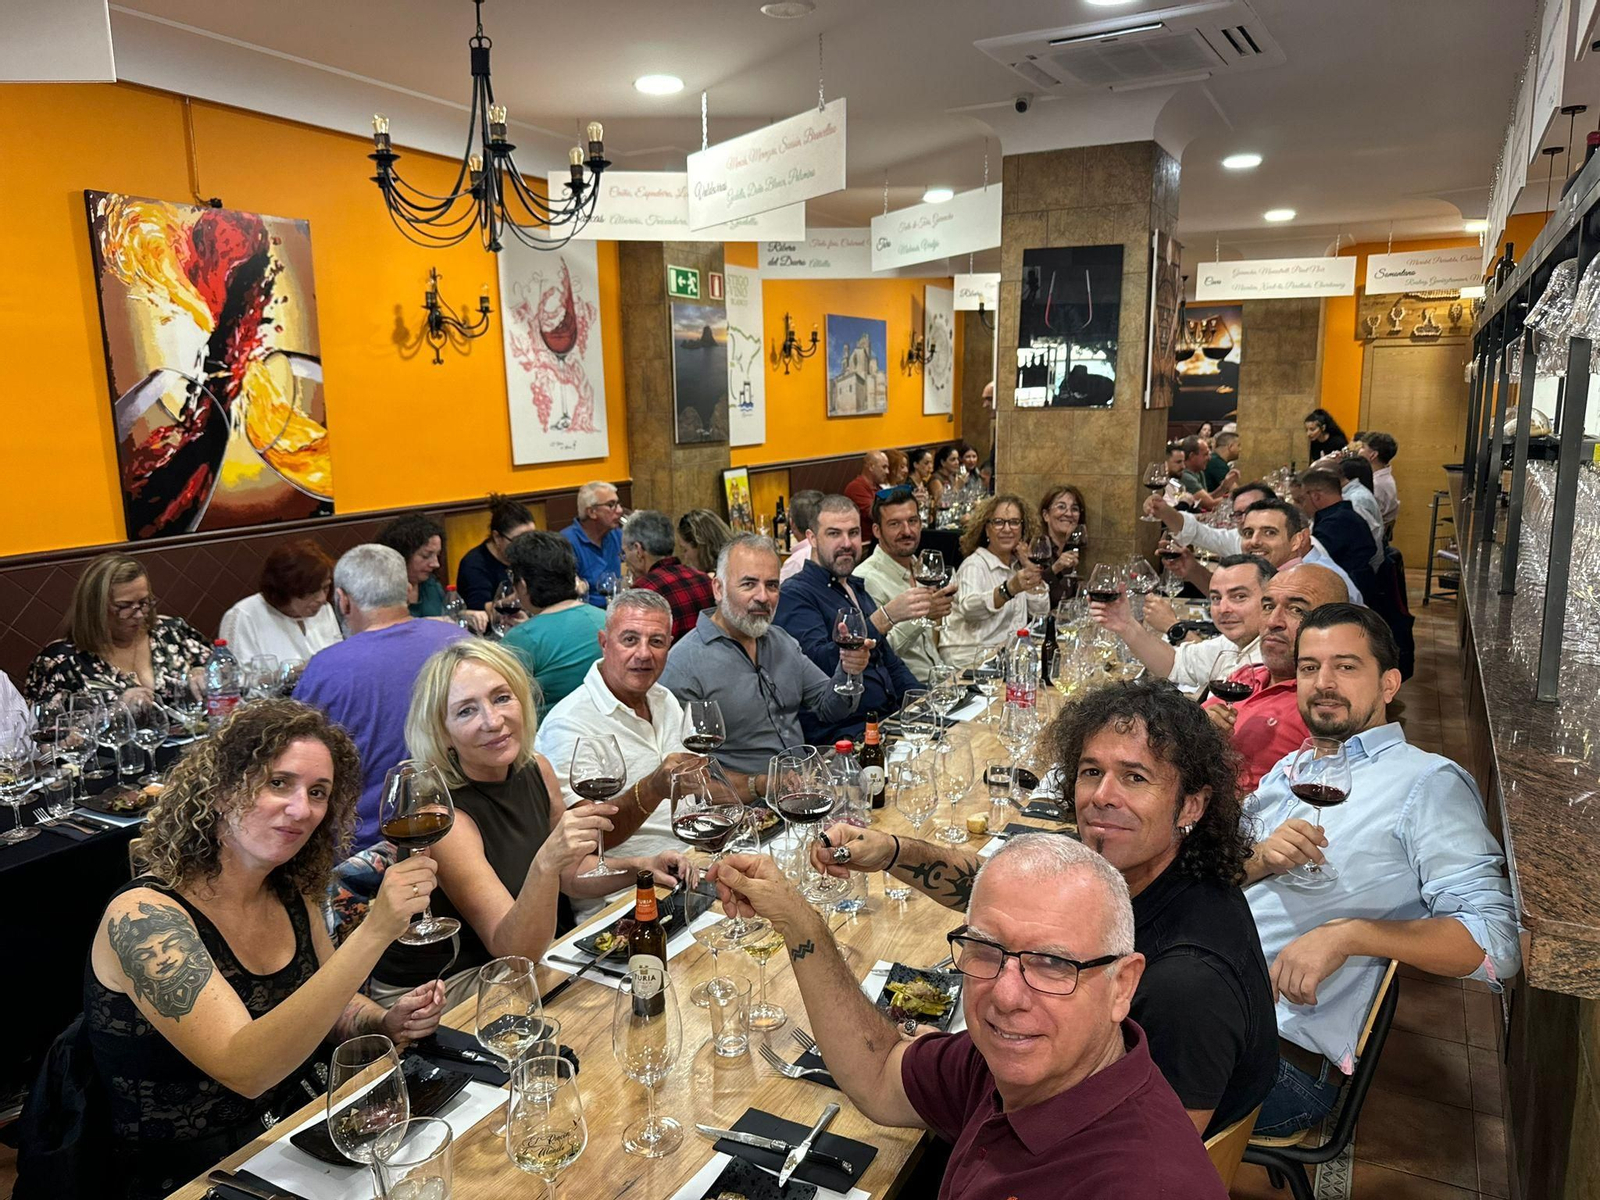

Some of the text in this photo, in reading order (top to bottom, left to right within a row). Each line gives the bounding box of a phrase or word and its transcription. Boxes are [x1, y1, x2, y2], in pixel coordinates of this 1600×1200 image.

[767, 241, 796, 253] Ribera
[876, 238, 891, 252] Toro
[767, 255, 806, 267] del Duero
[1374, 268, 1416, 280] Somontano
[1204, 276, 1221, 287] Cava
[634, 973, 657, 982] TURIA
